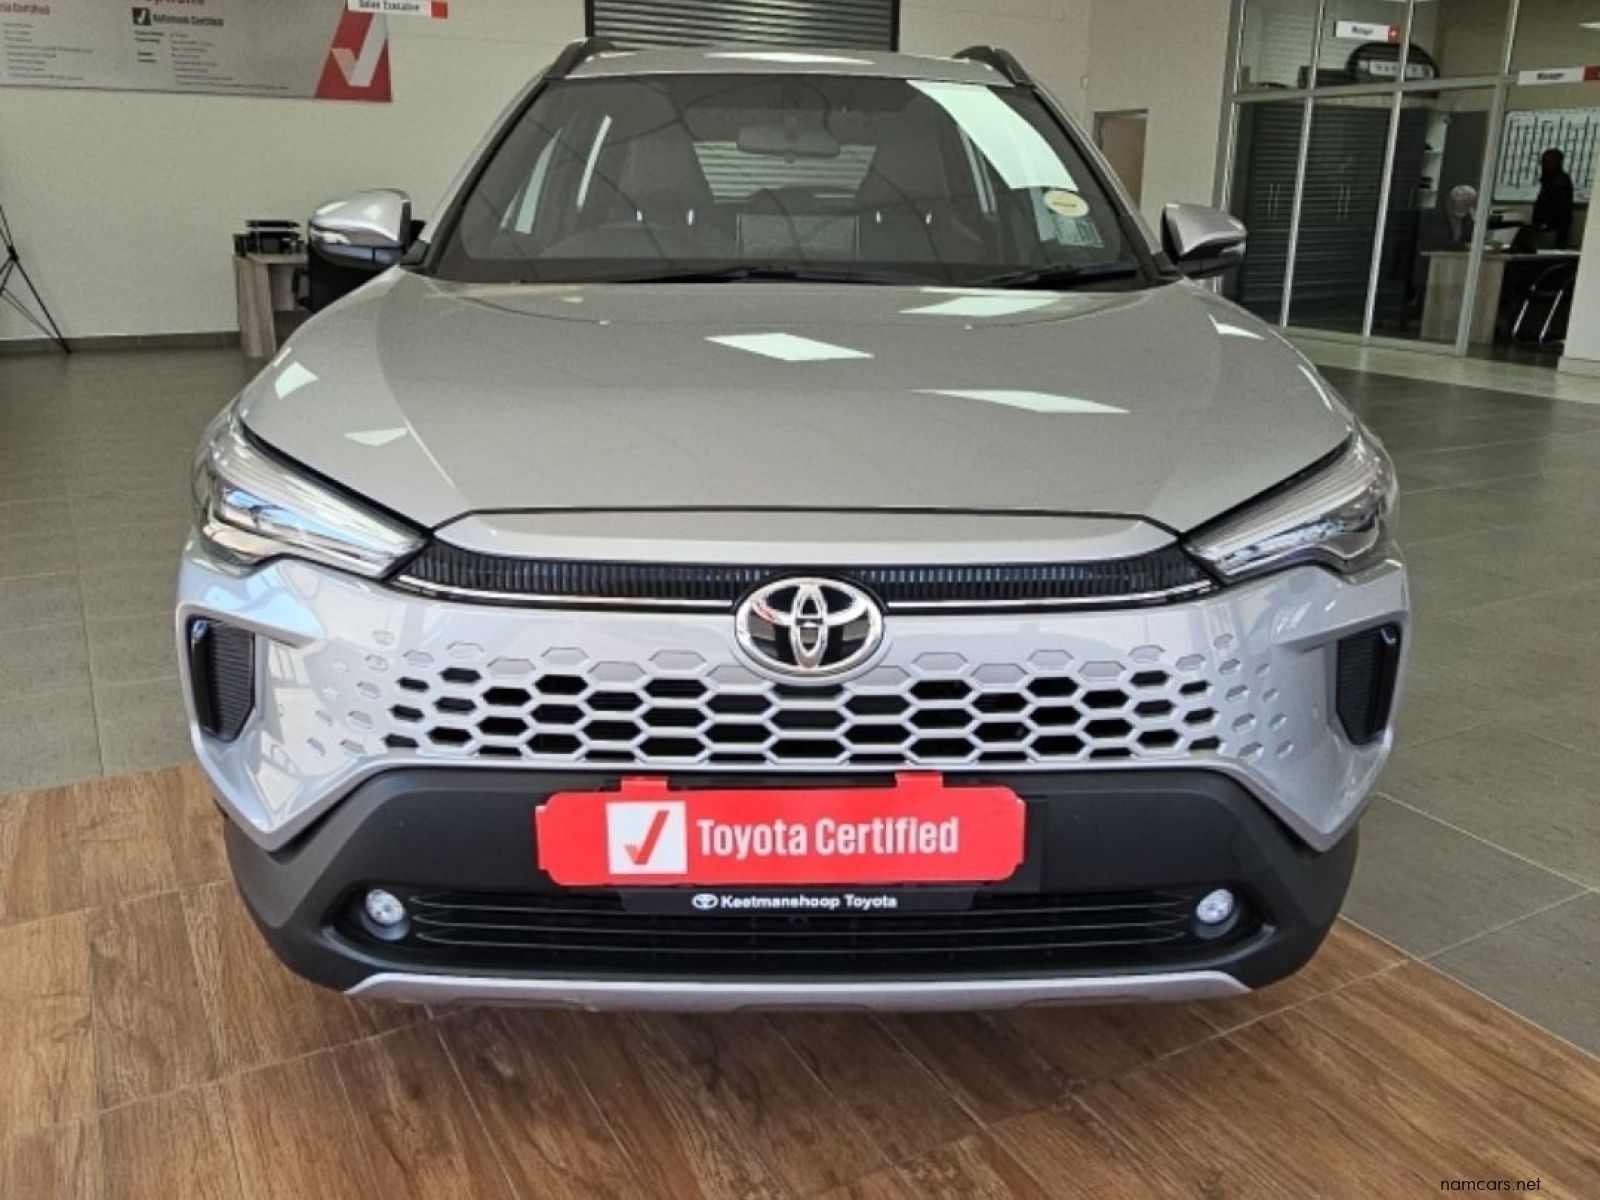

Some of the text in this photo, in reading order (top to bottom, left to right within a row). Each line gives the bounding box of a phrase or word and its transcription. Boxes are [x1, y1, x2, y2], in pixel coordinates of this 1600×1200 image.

[697, 817, 959, 860] Toyota Certified
[721, 894, 898, 910] Keetmanshoop Toyota
